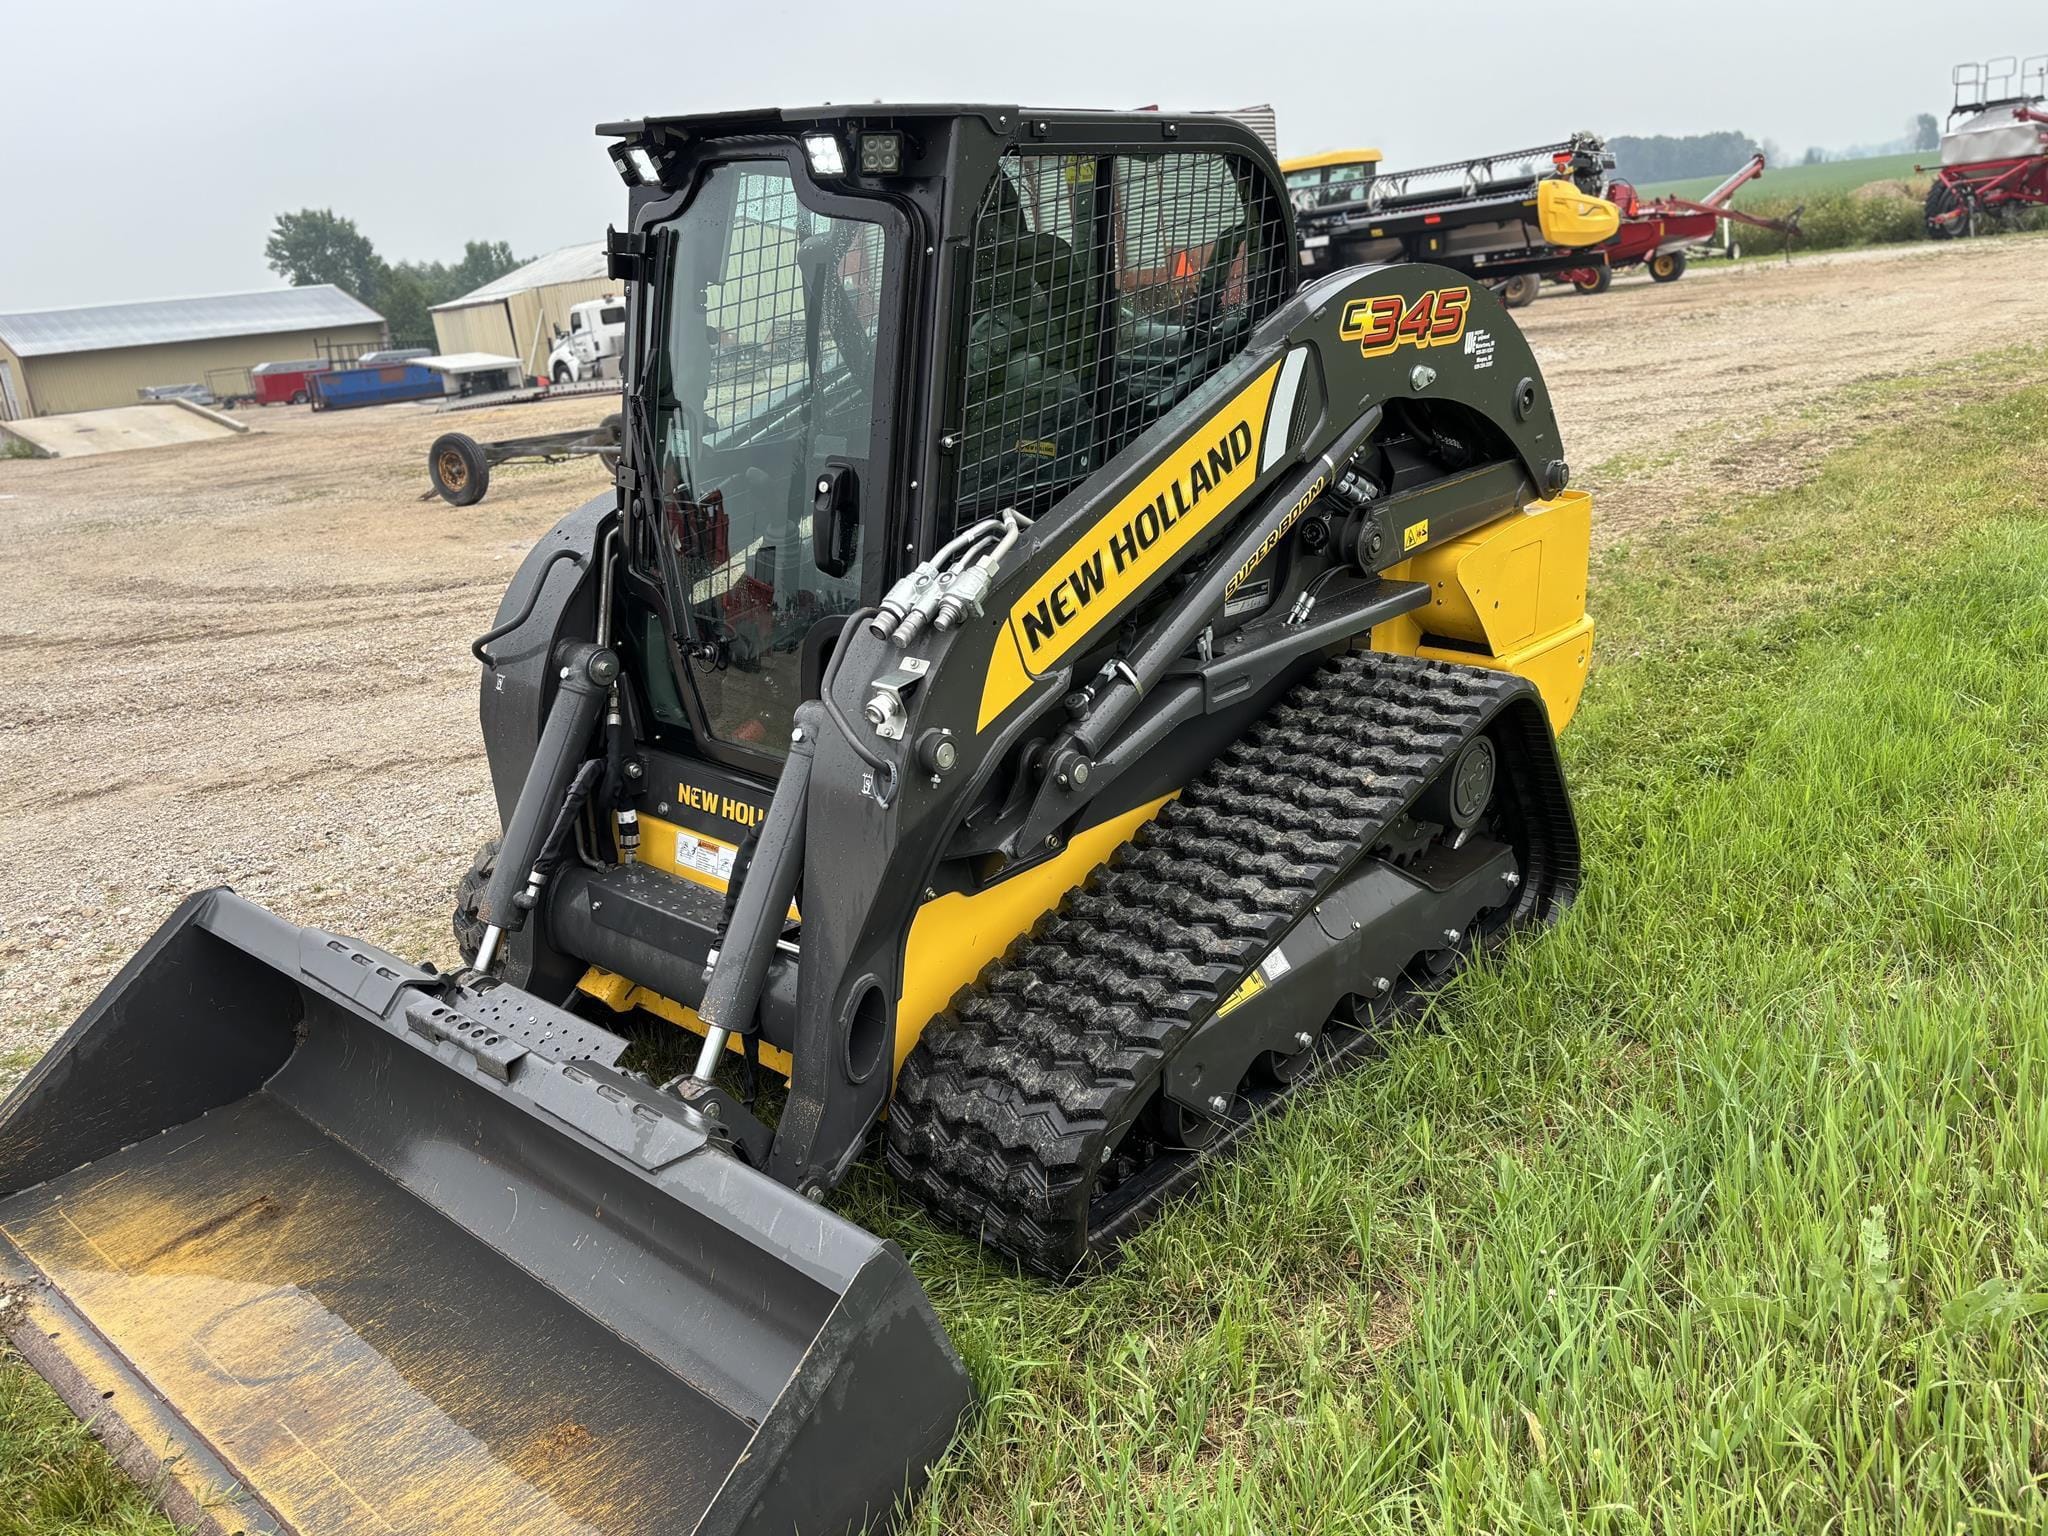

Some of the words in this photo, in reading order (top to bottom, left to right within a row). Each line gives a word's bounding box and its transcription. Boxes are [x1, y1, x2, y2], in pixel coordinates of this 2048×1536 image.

[1340, 286, 1471, 358] C345
[1021, 549, 1106, 654] NEW
[1108, 420, 1254, 576] HOLLAND
[1225, 529, 1279, 602] SUPER
[1278, 476, 1324, 540] BOOM
[677, 782, 719, 814] NEW
